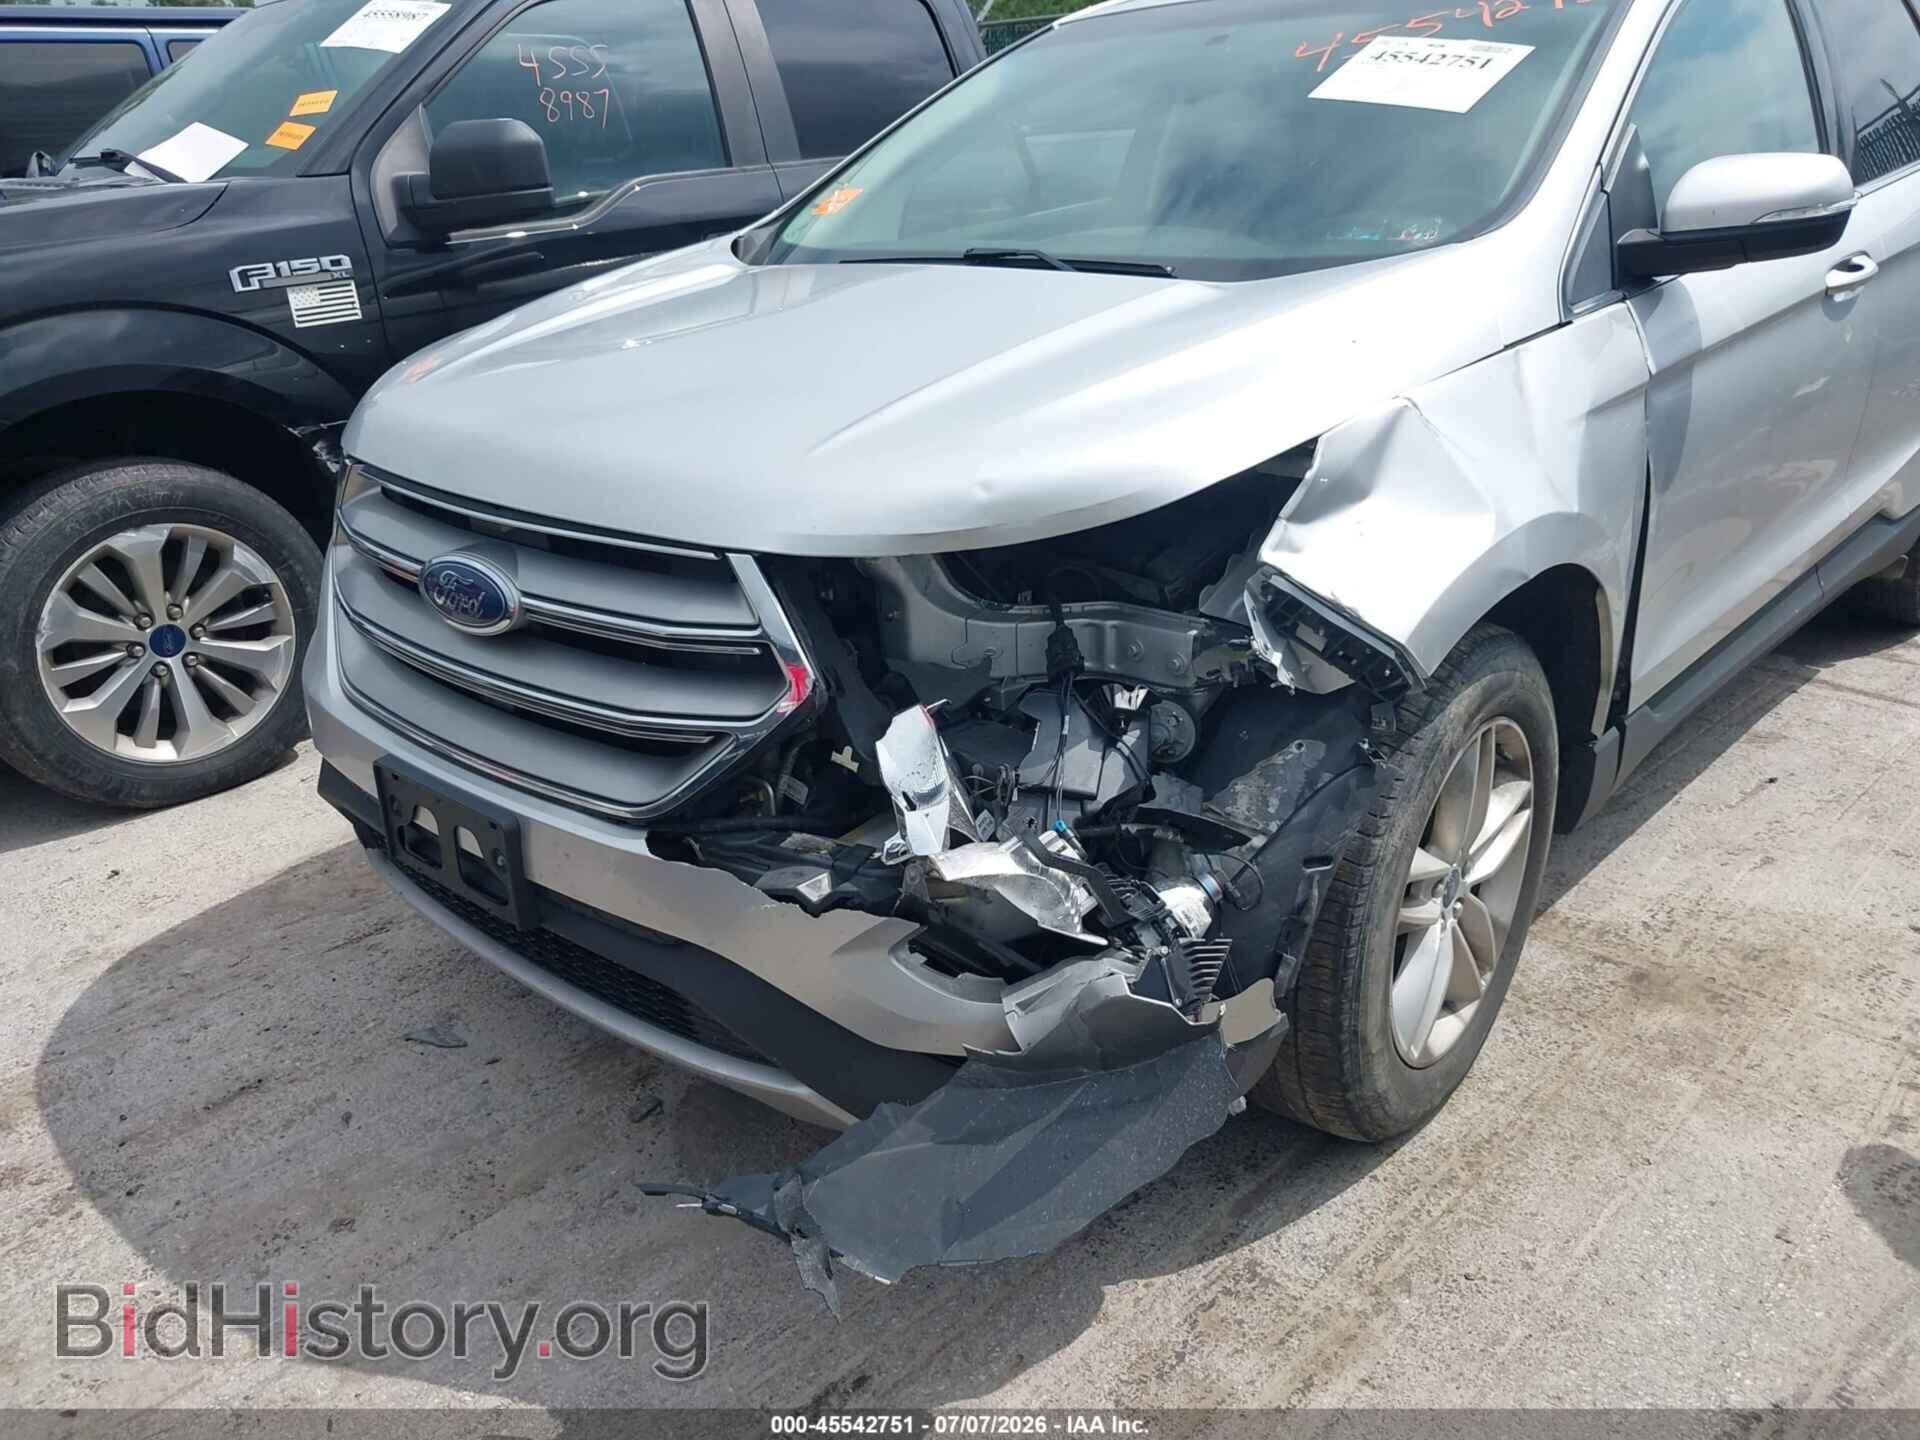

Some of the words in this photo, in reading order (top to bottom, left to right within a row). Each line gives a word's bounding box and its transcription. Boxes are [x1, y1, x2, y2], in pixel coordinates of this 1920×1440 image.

[517, 43, 608, 87] 4555
[1370, 50, 1494, 70] 45542751
[539, 87, 609, 129] 8987
[433, 569, 486, 618] Ford
